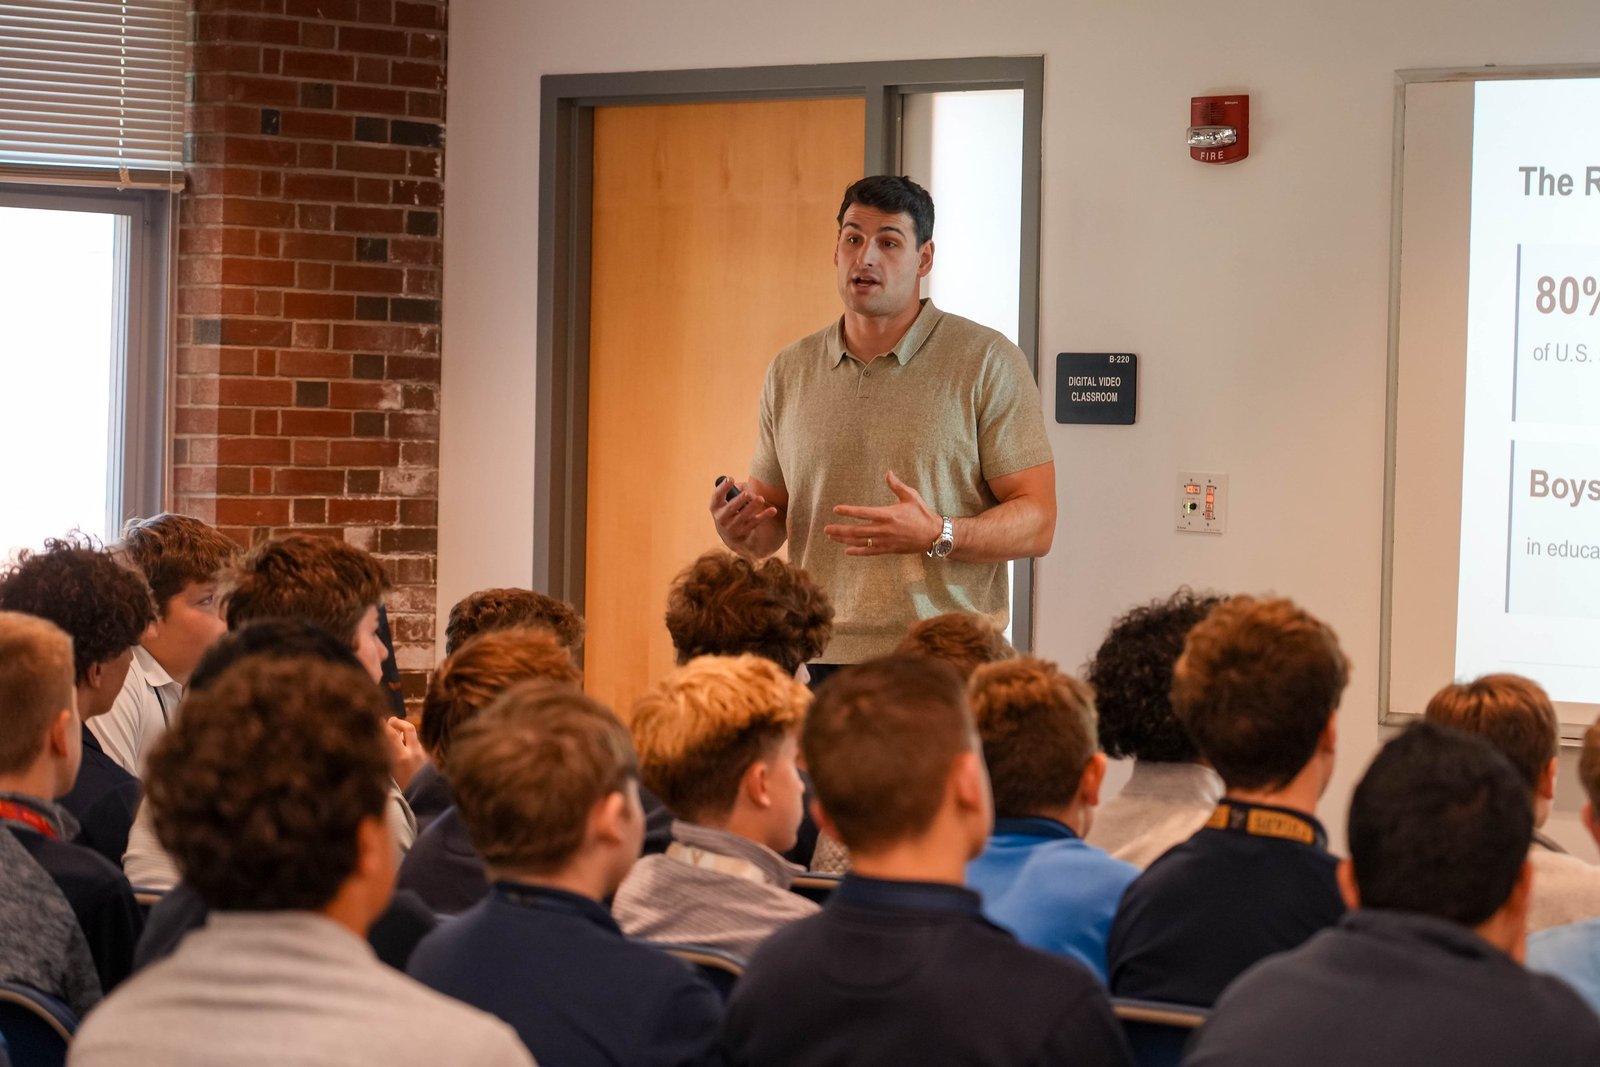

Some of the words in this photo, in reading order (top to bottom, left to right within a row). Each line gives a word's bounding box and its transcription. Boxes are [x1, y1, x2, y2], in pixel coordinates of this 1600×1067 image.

[1200, 151, 1224, 161] FIRE
[1518, 166, 1574, 197] The
[1109, 355, 1130, 364] B-220
[1533, 342, 1551, 361] of
[1556, 343, 1593, 363] U.S.
[1068, 376, 1097, 387] DIGITAL
[1098, 376, 1122, 387] VIDEO
[1071, 392, 1118, 402] CLASSROOM
[1529, 468, 1600, 508] Boys
[1526, 536, 1541, 556] in
[1547, 539, 1600, 560] educa
